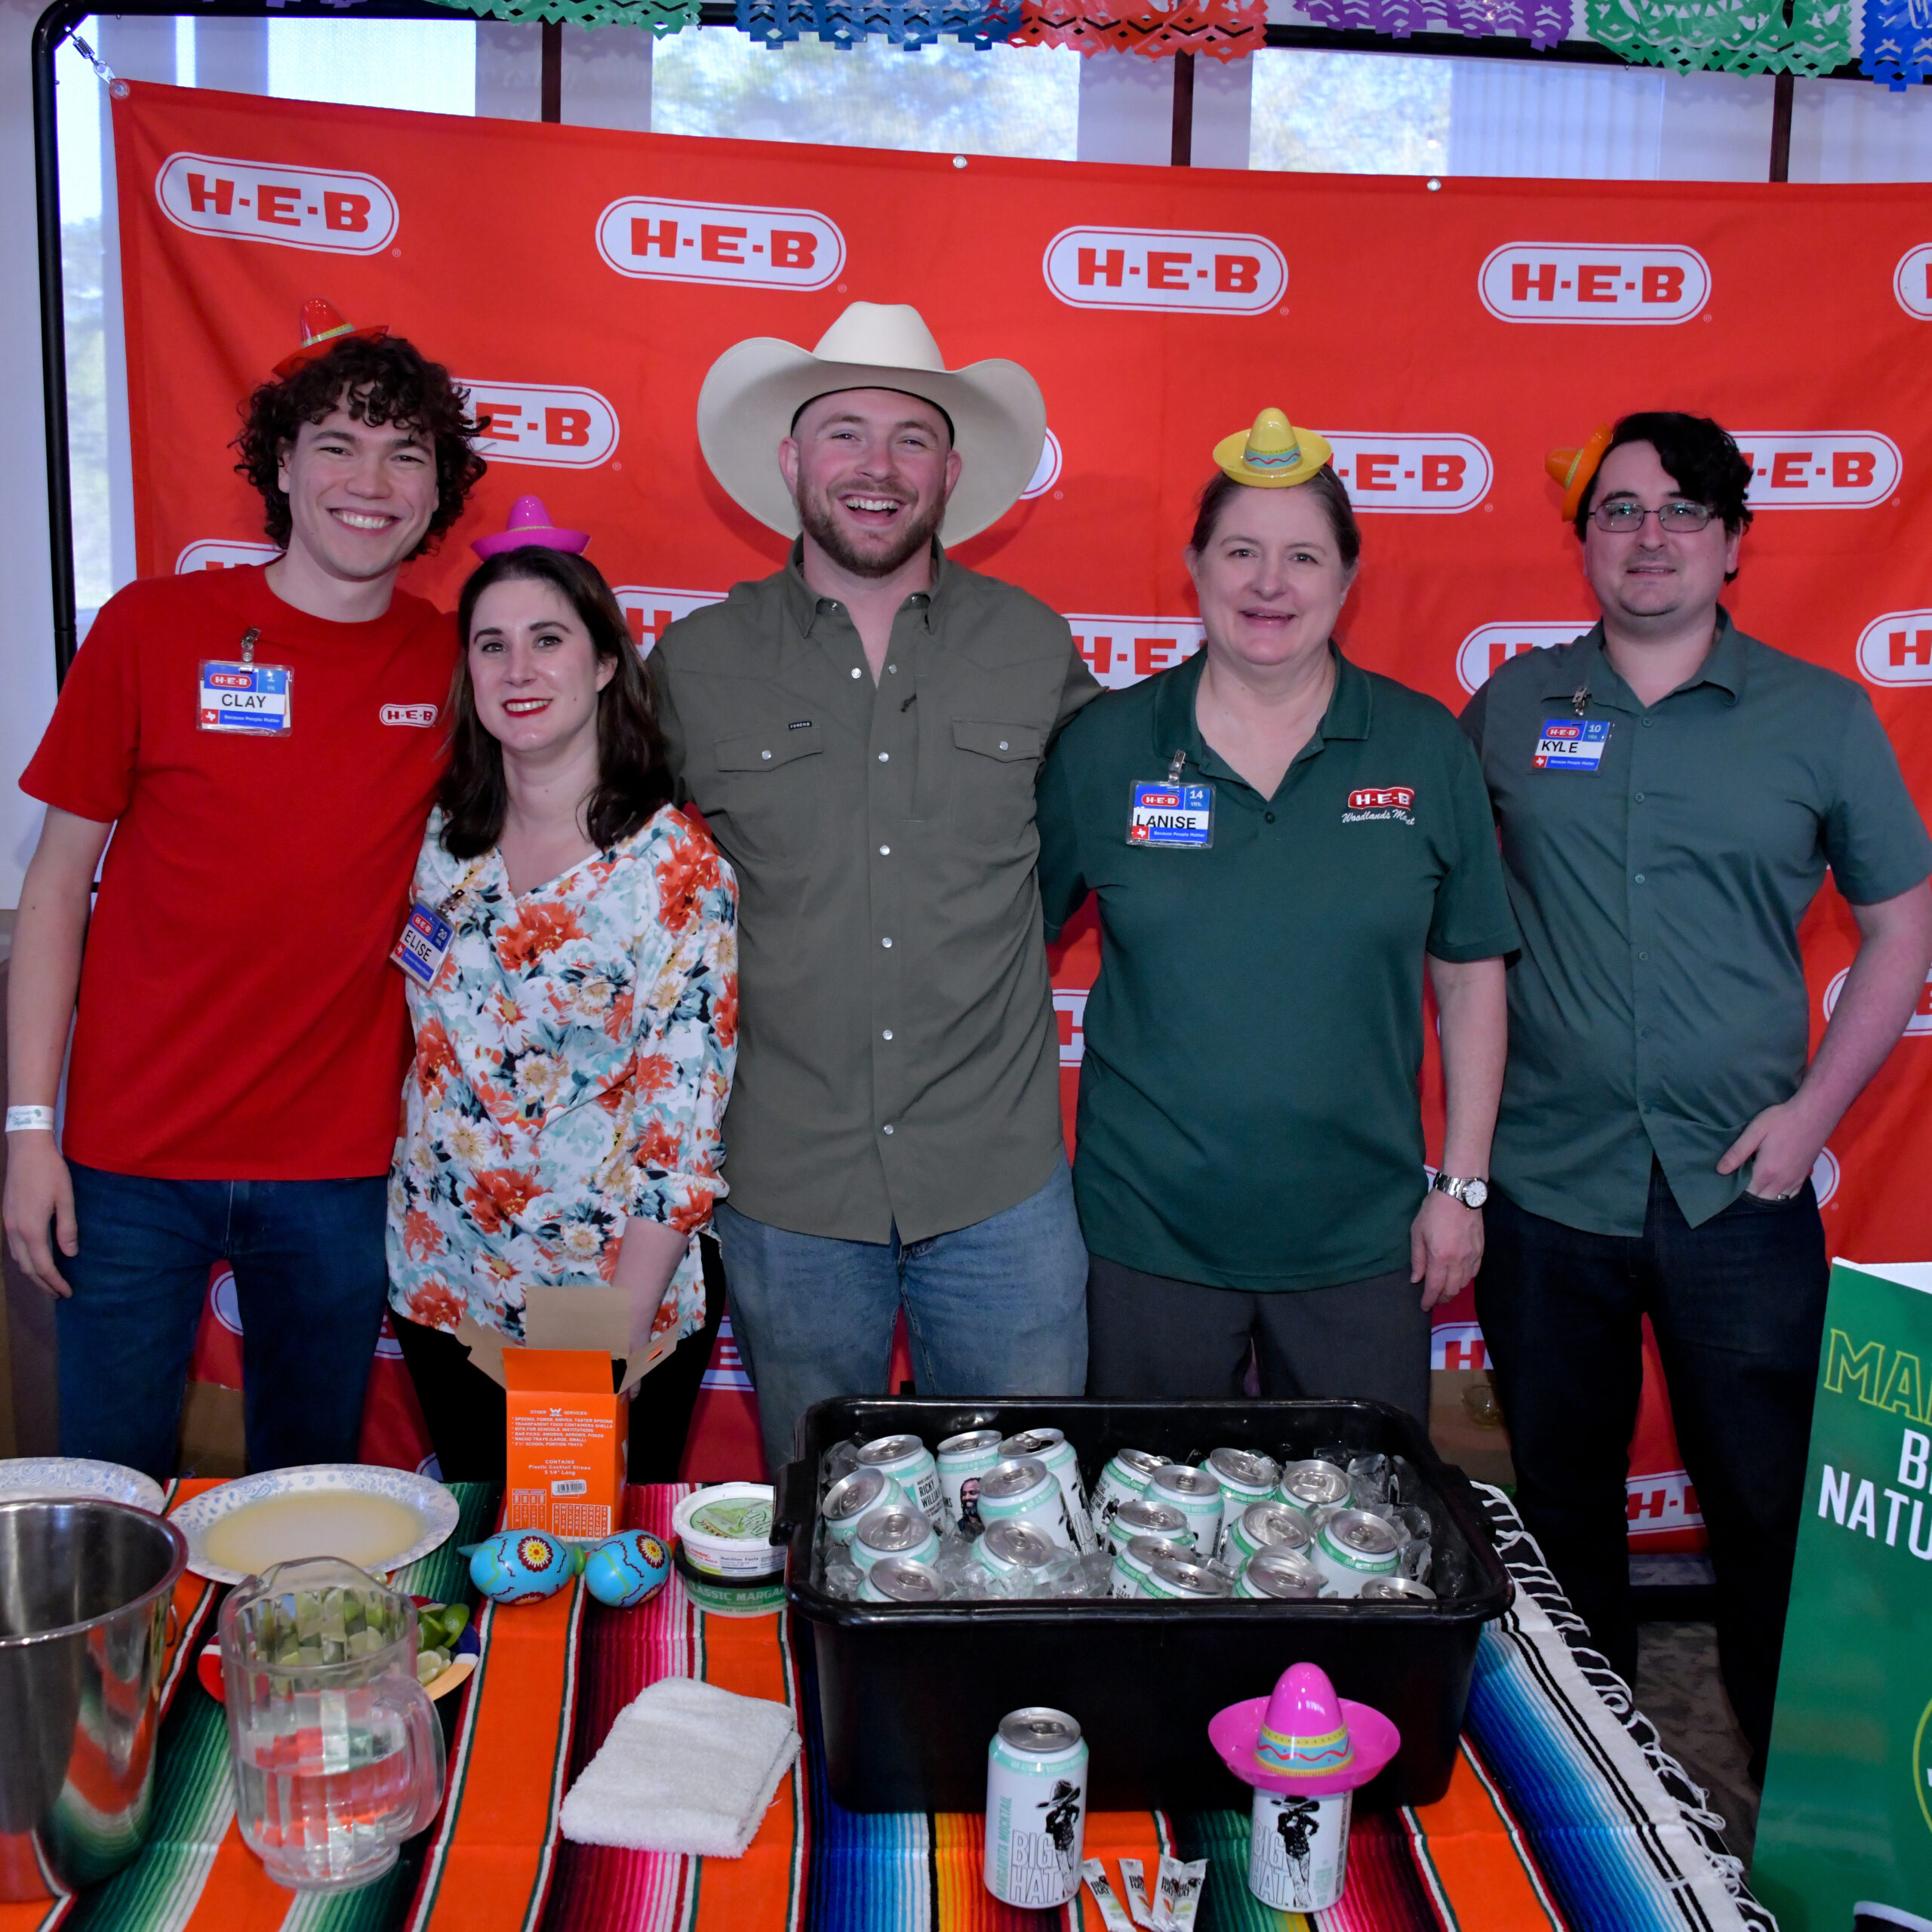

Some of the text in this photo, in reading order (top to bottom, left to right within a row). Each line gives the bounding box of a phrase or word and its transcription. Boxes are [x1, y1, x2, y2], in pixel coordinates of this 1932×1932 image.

[186, 171, 371, 232] H-E-B
[630, 217, 818, 269] H-E-B
[1078, 247, 1261, 294] H-E-B
[1512, 263, 1685, 303] H-E-B
[475, 401, 592, 447] E-B
[1327, 453, 1467, 491] -E-B
[1740, 451, 1876, 488] -E-B
[214, 676, 248, 686] H-E-B
[222, 694, 266, 709] CLAY
[387, 710, 433, 721] H-E-B
[1588, 724, 1601, 733] 10
[1541, 740, 1579, 753] KYLE
[1146, 796, 1176, 804] H-E-B
[1189, 790, 1204, 799] 14
[1355, 792, 1411, 805] H-E-B
[1136, 814, 1197, 830] LANISE
[1341, 810, 1391, 823] Woodlands
[404, 930, 432, 962] ELISE
[438, 928, 448, 940] 20
[1823, 1327, 1932, 1427] MA
[918, 1479, 935, 1497] RICKY
[995, 1795, 1012, 1899] MARGARITA MOCKTAIL
[1012, 1829, 1058, 1869] BIG
[1253, 1819, 1285, 1870] BIG
[1009, 1865, 1063, 1904] HAT
[1251, 1857, 1291, 1906] HAT
